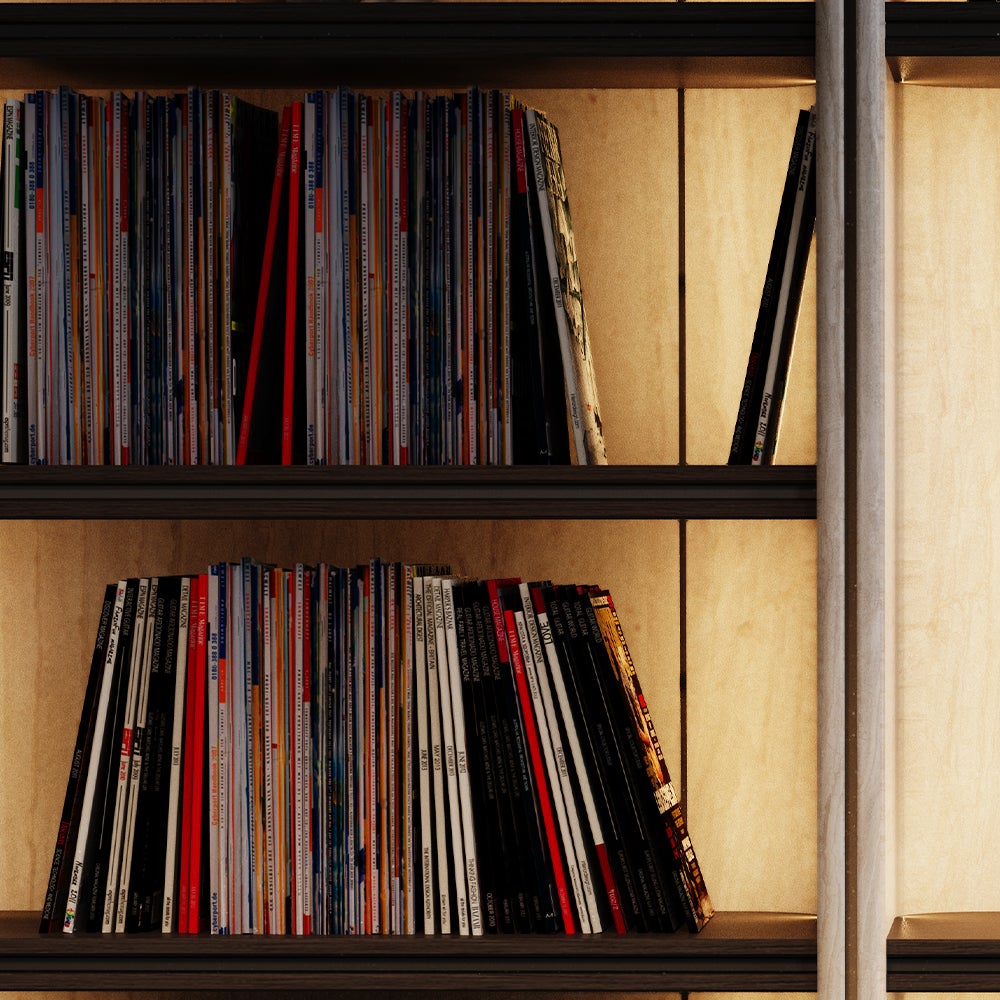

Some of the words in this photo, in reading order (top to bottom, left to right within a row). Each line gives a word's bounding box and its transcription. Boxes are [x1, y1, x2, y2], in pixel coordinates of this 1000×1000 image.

[5, 117, 13, 139] MAGAZINE
[291, 124, 299, 144] TIME
[528, 123, 538, 145] INTERIOR
[532, 146, 541, 165] DESIGN
[534, 165, 545, 191] MAGAZINE
[138, 585, 146, 598] ESPN
[433, 585, 441, 602] DETAIL
[136, 598, 145, 619] MAGAZINE
[179, 603, 187, 628] MAGAZINE
[198, 595, 206, 616] TIME
[414, 593, 422, 626] ARCHITECTURAL
[434, 603, 443, 629] MAGAZINE
[522, 596, 534, 618] INTERIOR
[445, 610, 454, 629] BAZAAR
[527, 619, 538, 638] DESIGN
[426, 617, 434, 645] MAGAZINE
[507, 629, 517, 650] TIME
[539, 621, 553, 644] LOVE
[531, 638, 543, 663] MAGAZINE
